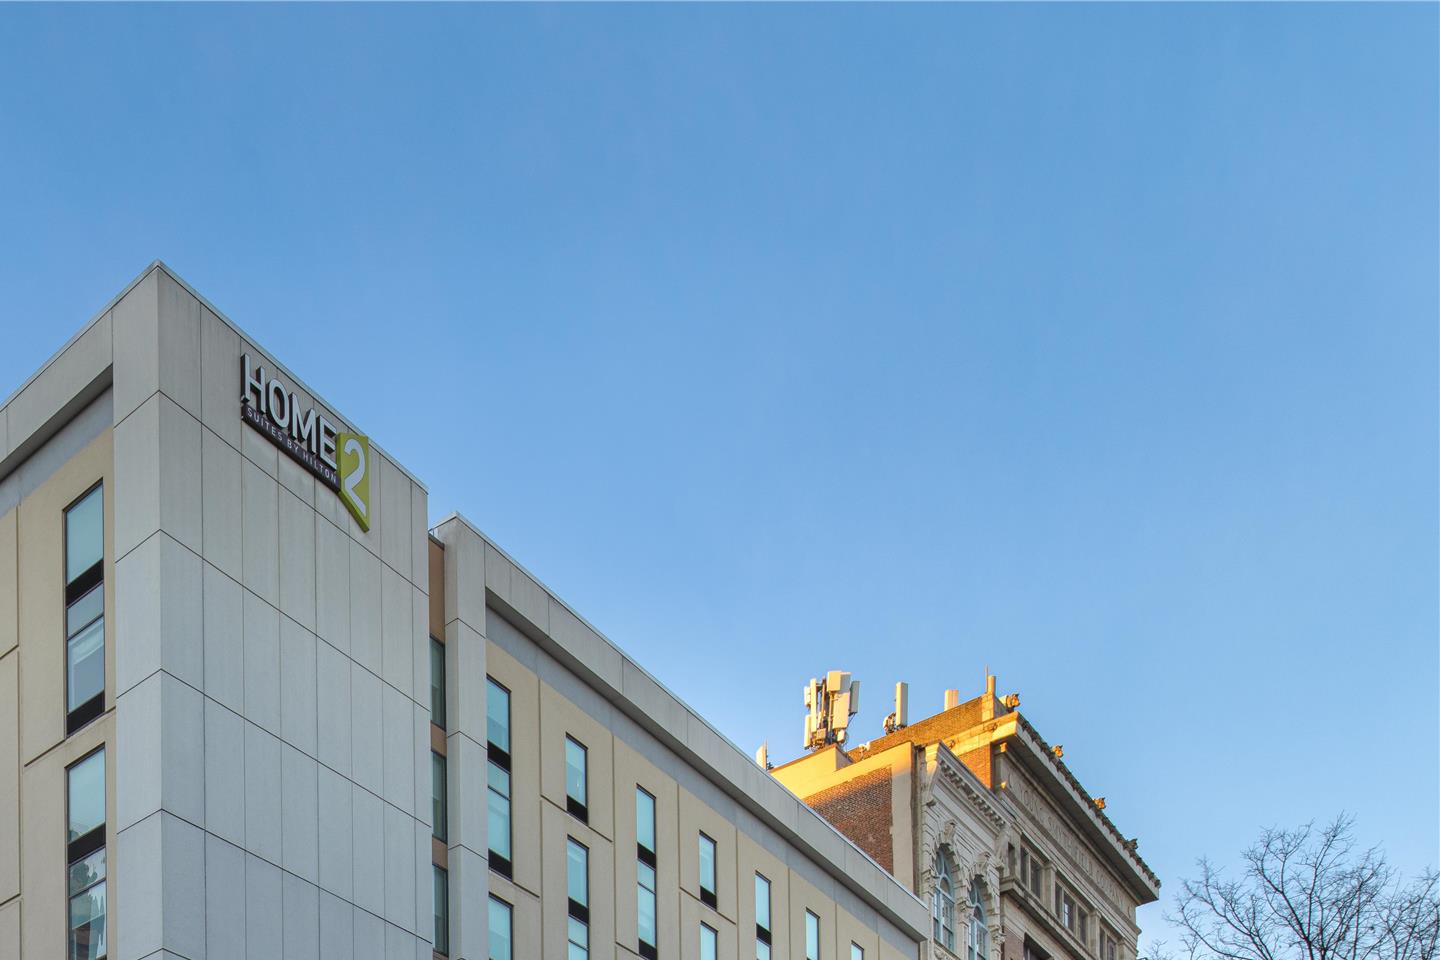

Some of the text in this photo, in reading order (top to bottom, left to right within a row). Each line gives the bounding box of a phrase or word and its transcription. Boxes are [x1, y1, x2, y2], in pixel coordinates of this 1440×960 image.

[247, 407, 338, 485] SUITES BY HILTON
